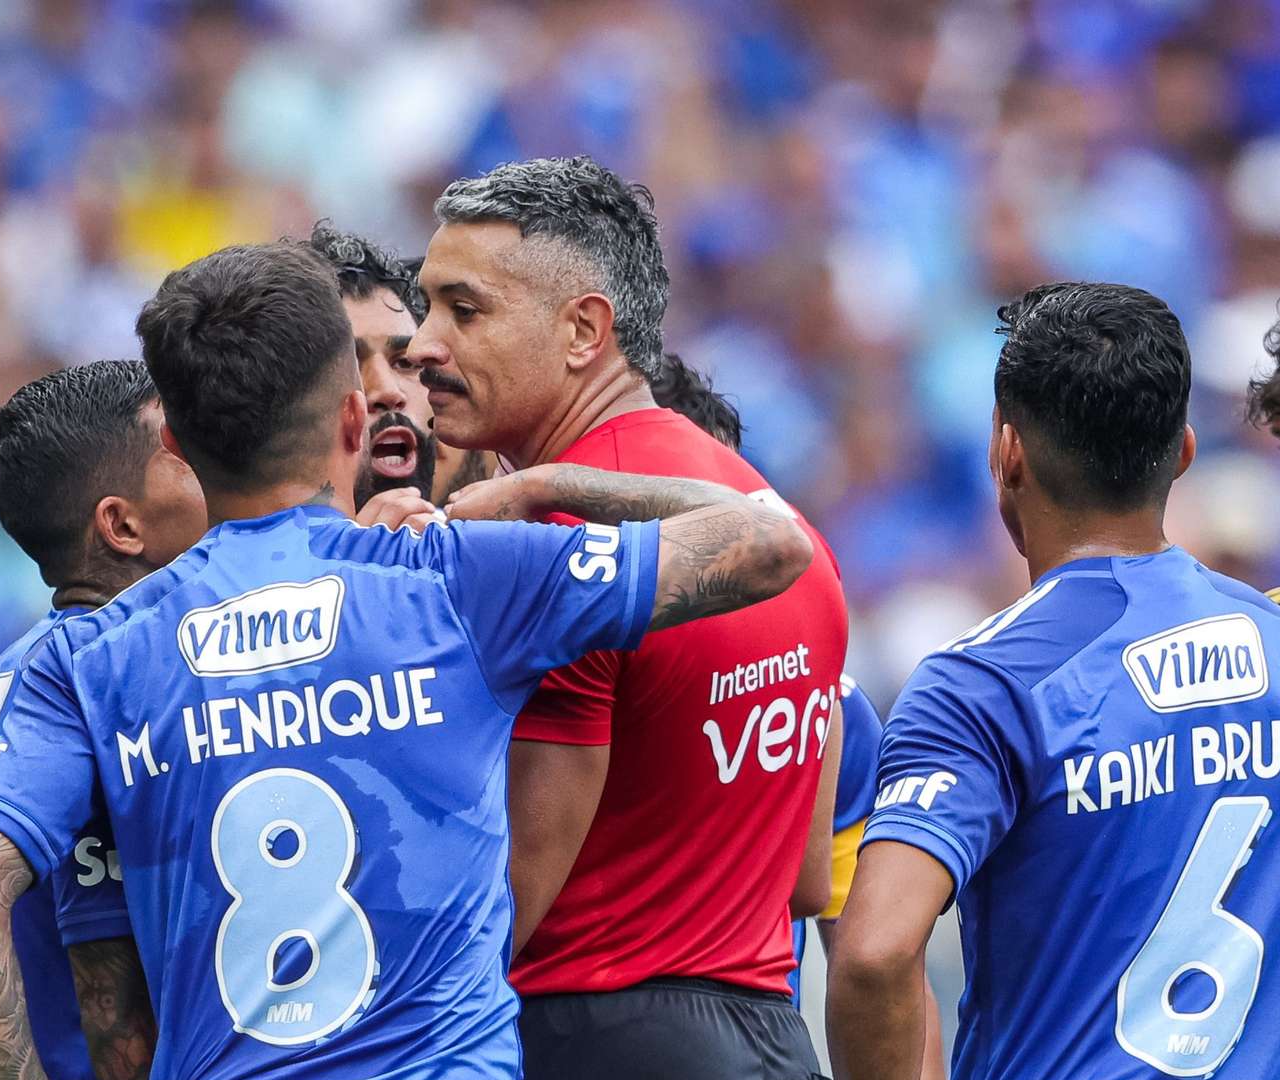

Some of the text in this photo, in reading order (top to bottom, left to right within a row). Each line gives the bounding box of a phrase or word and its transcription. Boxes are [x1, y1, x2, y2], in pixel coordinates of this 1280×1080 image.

[187, 605, 323, 661] Vilma
[710, 643, 811, 705] Internet
[1137, 642, 1257, 696] Vilma
[116, 667, 445, 787] M. HENRIQUE
[874, 771, 958, 812] urf
[1062, 734, 1175, 815] KAIKI
[211, 767, 378, 1046] 8
[1115, 796, 1270, 1079] 6
